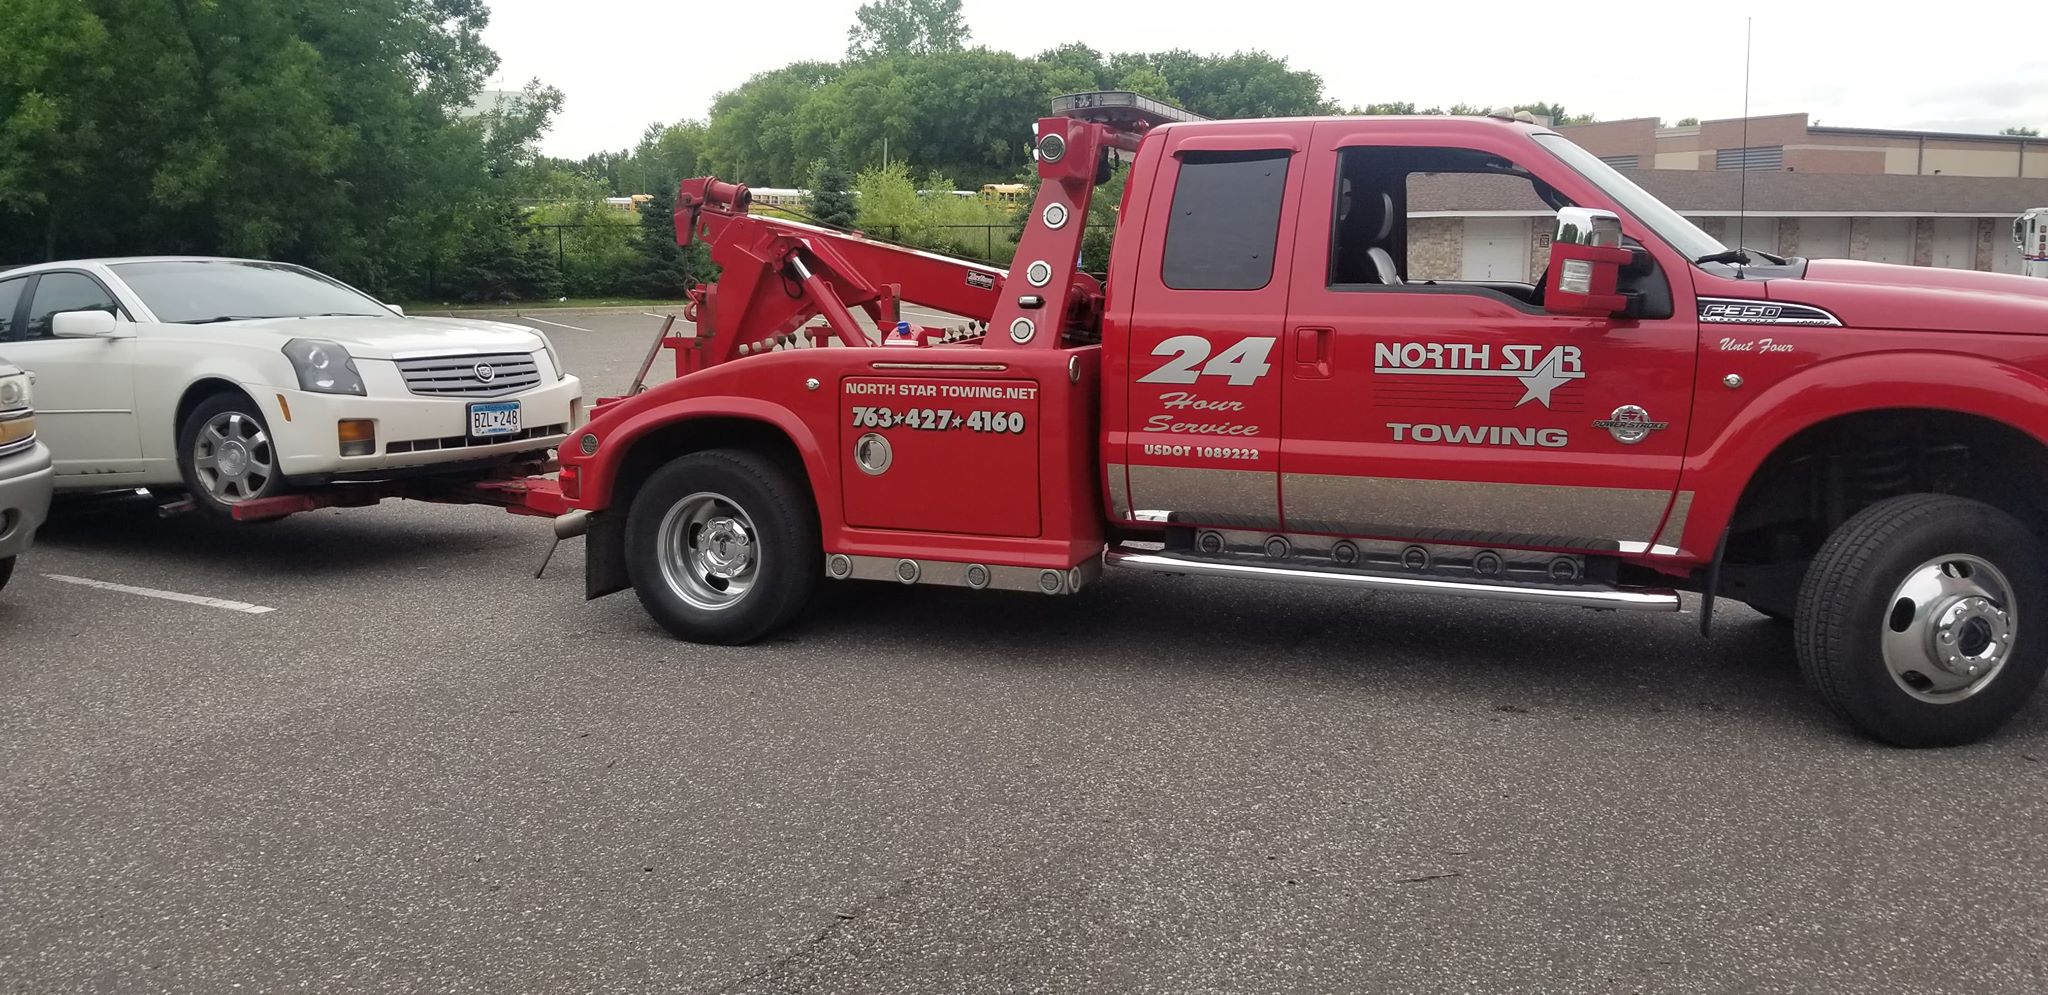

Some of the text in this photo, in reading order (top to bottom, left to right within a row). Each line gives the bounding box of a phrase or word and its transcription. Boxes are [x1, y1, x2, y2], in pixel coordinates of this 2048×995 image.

[1720, 337, 1794, 354] Unit Four
[1135, 335, 1277, 386] 24
[1374, 342, 1583, 373] NORTH STAR
[845, 383, 1037, 399] NORTH STAR TOWING.NET
[1159, 391, 1244, 411] Hour
[474, 410, 518, 428] BZL 248
[1143, 414, 1260, 436] Service
[1386, 422, 1568, 447] TOWING
[1144, 445, 1258, 460] USDOT 1089222
